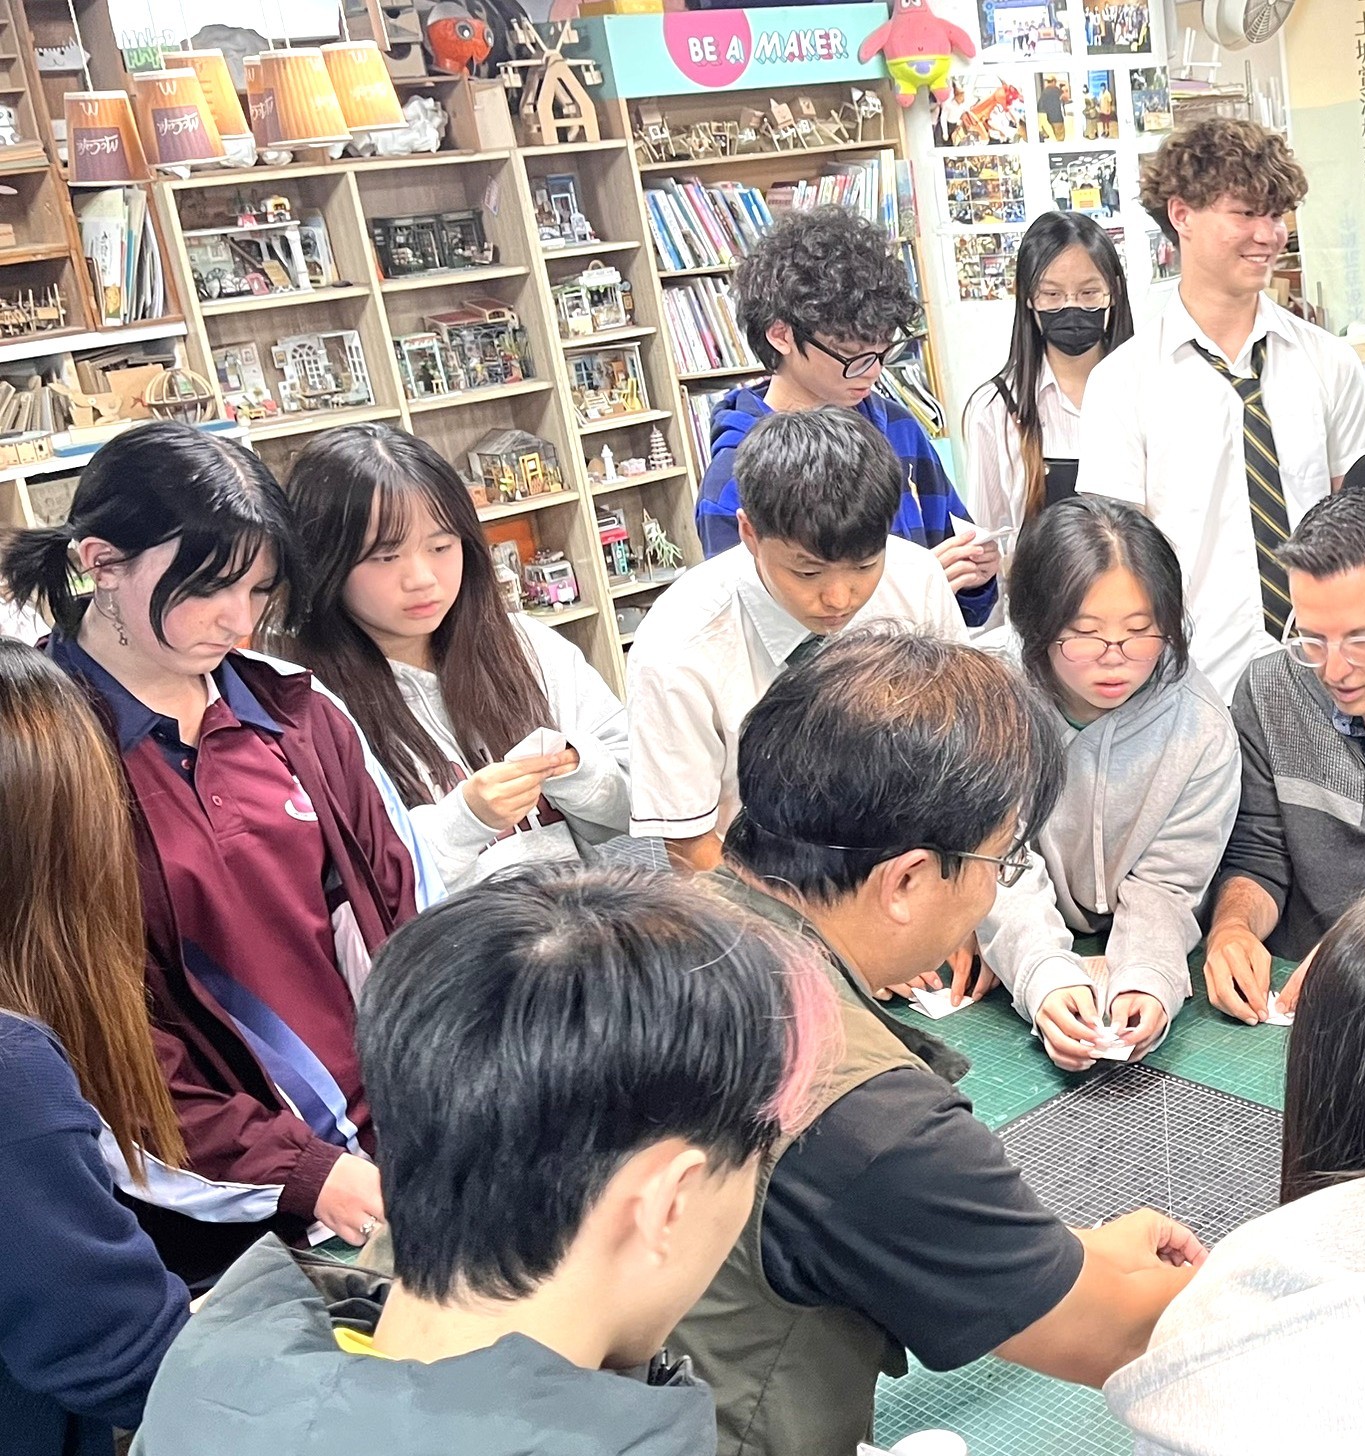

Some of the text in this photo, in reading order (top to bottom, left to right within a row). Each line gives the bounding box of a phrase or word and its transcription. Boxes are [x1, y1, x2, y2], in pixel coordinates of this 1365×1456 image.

[688, 27, 849, 65] BE A MAKER
